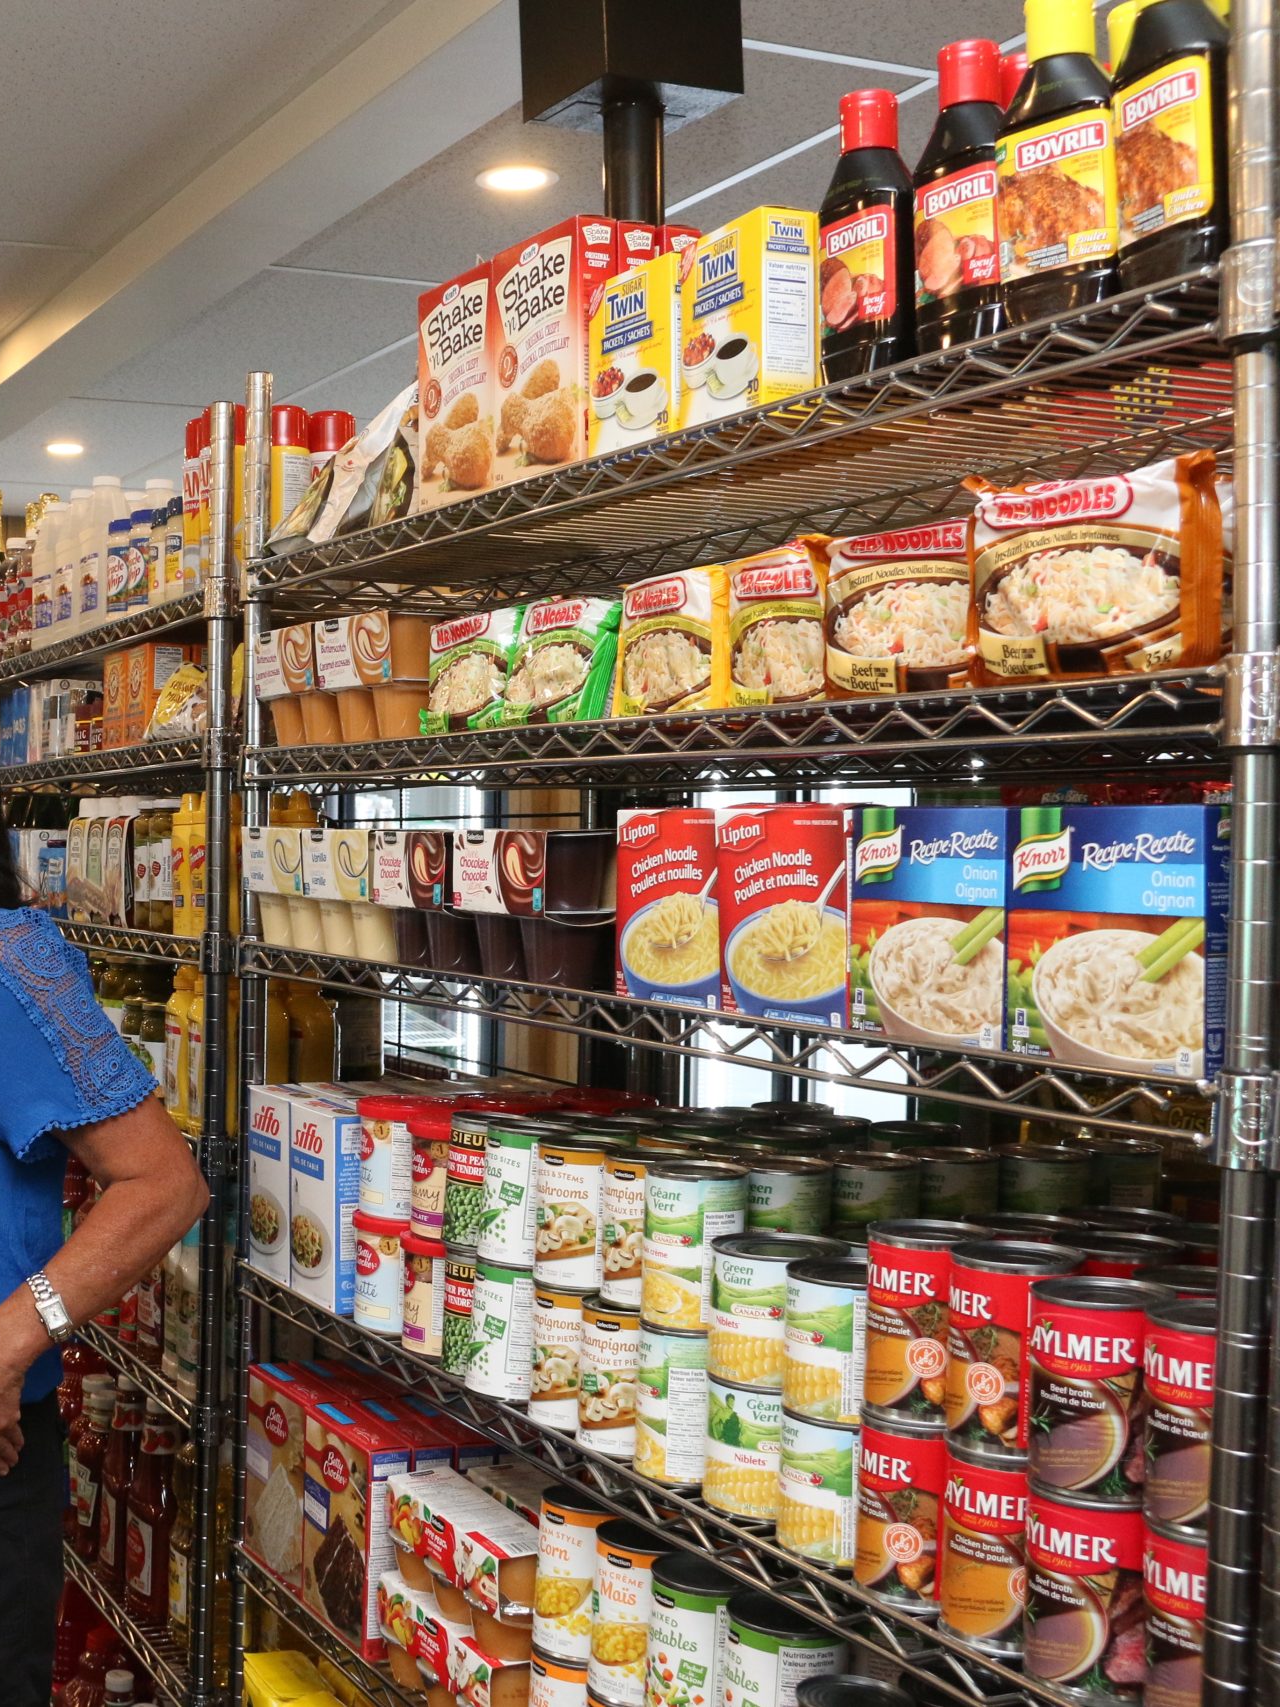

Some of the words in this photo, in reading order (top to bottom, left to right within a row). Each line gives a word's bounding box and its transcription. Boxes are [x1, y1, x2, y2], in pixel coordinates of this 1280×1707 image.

[1125, 73, 1194, 126] BOVRIL
[1022, 123, 1101, 166] BOVRIL
[927, 174, 992, 214] BOVRIL
[1167, 199, 1204, 218] Chicken
[771, 221, 803, 238] TWIN
[830, 220, 882, 253] BOVRIL
[1075, 231, 1108, 245] Poulet
[523, 246, 537, 262] Kraft
[713, 237, 734, 257] SUGAR
[1070, 243, 1111, 257] Chicken
[698, 250, 735, 284] TWIN
[503, 253, 565, 314] Shake
[622, 280, 643, 297] SUGAR
[445, 287, 458, 301] Kraft
[514, 283, 565, 332] Bake
[607, 291, 644, 322] TWIN
[428, 294, 483, 349] Shake
[439, 323, 483, 367] Bake
[848, 572, 874, 590] Instant
[852, 663, 873, 677] Beef
[622, 820, 656, 843] Lipton
[721, 822, 761, 845] Lipton
[379, 856, 402, 868] Chocolate
[631, 853, 664, 878] Chicken
[664, 846, 698, 863] Noodle
[858, 842, 899, 866] Knorr
[1016, 846, 1068, 868] Knorr
[460, 856, 490, 870] Chocolate
[734, 858, 771, 884] Chicken
[772, 850, 812, 867] Noodle
[380, 868, 401, 879] Chocolat
[461, 870, 489, 882] Chocolat
[630, 875, 658, 898] Poulet
[658, 871, 667, 880] et
[667, 864, 703, 881] nouilles
[962, 865, 998, 882] Onion
[1151, 869, 1195, 888] Onion
[735, 880, 766, 905] Poulet
[766, 877, 775, 887] et
[776, 870, 819, 888] nouilles
[955, 883, 998, 902] Oignon
[1142, 890, 1195, 912] Oignon
[1180, 1051, 1190, 1062] 20
[252, 1105, 280, 1136] sifto
[293, 1122, 323, 1154] sifto
[453, 1131, 486, 1147] SIEU
[307, 1160, 319, 1172] TABLE
[456, 1165, 484, 1176] TENDRE
[500, 1157, 521, 1168] SIZES
[558, 1172, 584, 1184] STEMS
[614, 1170, 635, 1179] Selection
[500, 1193, 520, 1204] SEASON
[649, 1185, 682, 1202] Géant
[653, 1199, 675, 1212] Vert
[654, 1235, 678, 1245] CANADA
[722, 1260, 754, 1276] Green
[723, 1272, 752, 1287] Giant
[868, 1263, 936, 1297] YLMER
[484, 1290, 503, 1303] SIZES
[950, 1286, 992, 1320] MER
[734, 1307, 766, 1318] CANADA
[885, 1316, 904, 1326] broth
[596, 1321, 619, 1330] Selection
[715, 1315, 739, 1329] Niblets
[557, 1334, 579, 1343] PIEDS
[787, 1329, 809, 1343] CANADA
[888, 1326, 911, 1337] poulet
[1030, 1325, 1136, 1364] AYLMER
[1070, 1363, 1092, 1373] 1903
[1144, 1348, 1213, 1391] AYLME
[1040, 1389, 1067, 1405] Bouillon
[1069, 1396, 1079, 1406] de
[1050, 1383, 1067, 1394] Beef
[1069, 1387, 1093, 1399] broth
[747, 1399, 781, 1412] Géan
[269, 1407, 284, 1427] Betty
[753, 1411, 779, 1423] Vert
[1154, 1409, 1169, 1422] Beef
[1170, 1415, 1194, 1428] broth
[265, 1418, 287, 1439] Crocker
[1171, 1424, 1182, 1436] de
[328, 1451, 343, 1471] Betty
[734, 1453, 766, 1466] Niblets
[860, 1449, 912, 1484] LMER
[323, 1464, 347, 1486] Crocker
[784, 1469, 808, 1482] CANADA
[869, 1508, 888, 1520] poulet
[556, 1532, 583, 1547] STYLE
[955, 1533, 982, 1550] Chicken
[983, 1542, 1005, 1554] broth
[540, 1536, 570, 1562] Corn
[950, 1540, 974, 1557] Bouillon
[975, 1549, 985, 1559] de
[986, 1553, 1014, 1565] poulet
[608, 1555, 631, 1567] Selection
[1035, 1574, 1050, 1587] Beef
[1051, 1582, 1073, 1594] broth
[1144, 1553, 1207, 1603] YLME
[601, 1578, 637, 1606] Maïs
[1050, 1591, 1061, 1601] de
[651, 1611, 678, 1628] MIXED
[1167, 1625, 1191, 1638] broth
[649, 1629, 698, 1652] getables
[782, 1651, 815, 1660] Nutrition
[816, 1651, 834, 1660] Facts
[782, 1659, 807, 1668] Valeur
[808, 1659, 835, 1667] nutritive
[683, 1662, 704, 1673] Packed
[678, 1673, 703, 1687] SEASON
